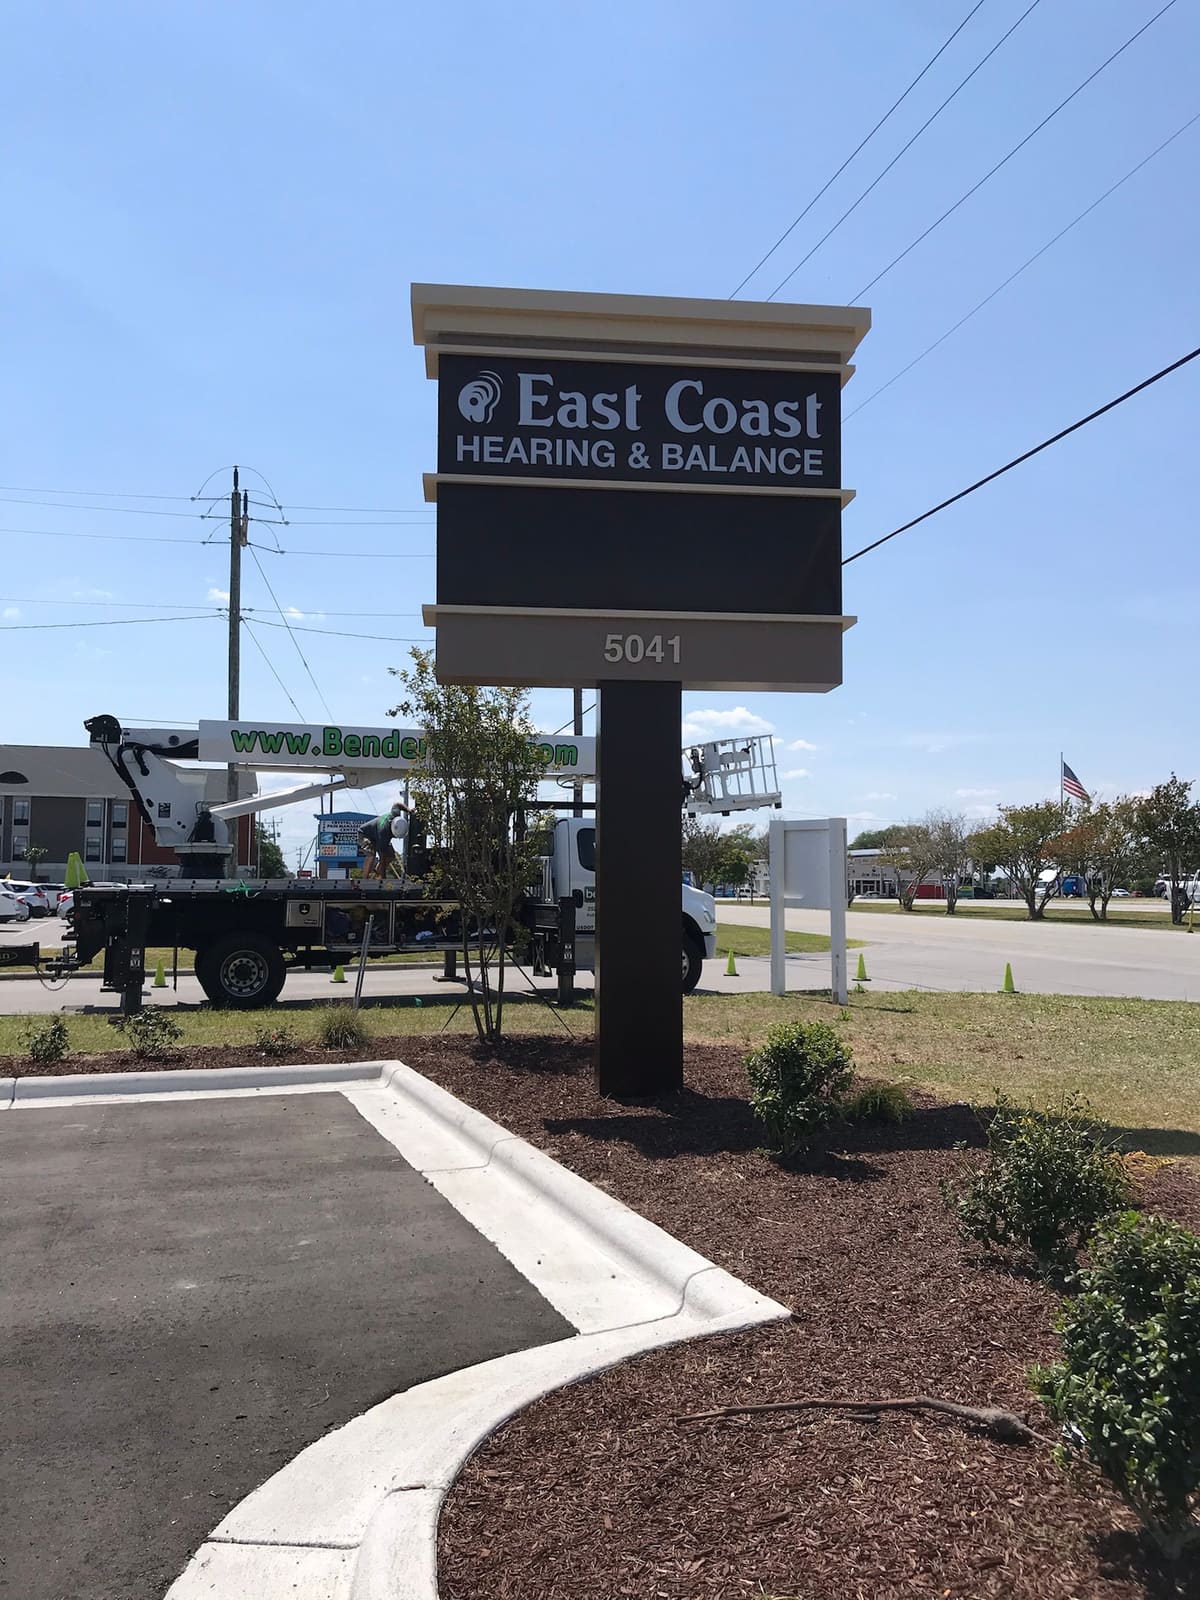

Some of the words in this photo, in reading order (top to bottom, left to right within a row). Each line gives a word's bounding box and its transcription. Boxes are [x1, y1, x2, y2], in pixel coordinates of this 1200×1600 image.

[517, 372, 642, 431] East
[664, 379, 823, 439] Coast
[456, 434, 616, 468] HEARING
[627, 441, 651, 469] &
[661, 442, 824, 476] BALANCE
[603, 634, 681, 664] 5041
